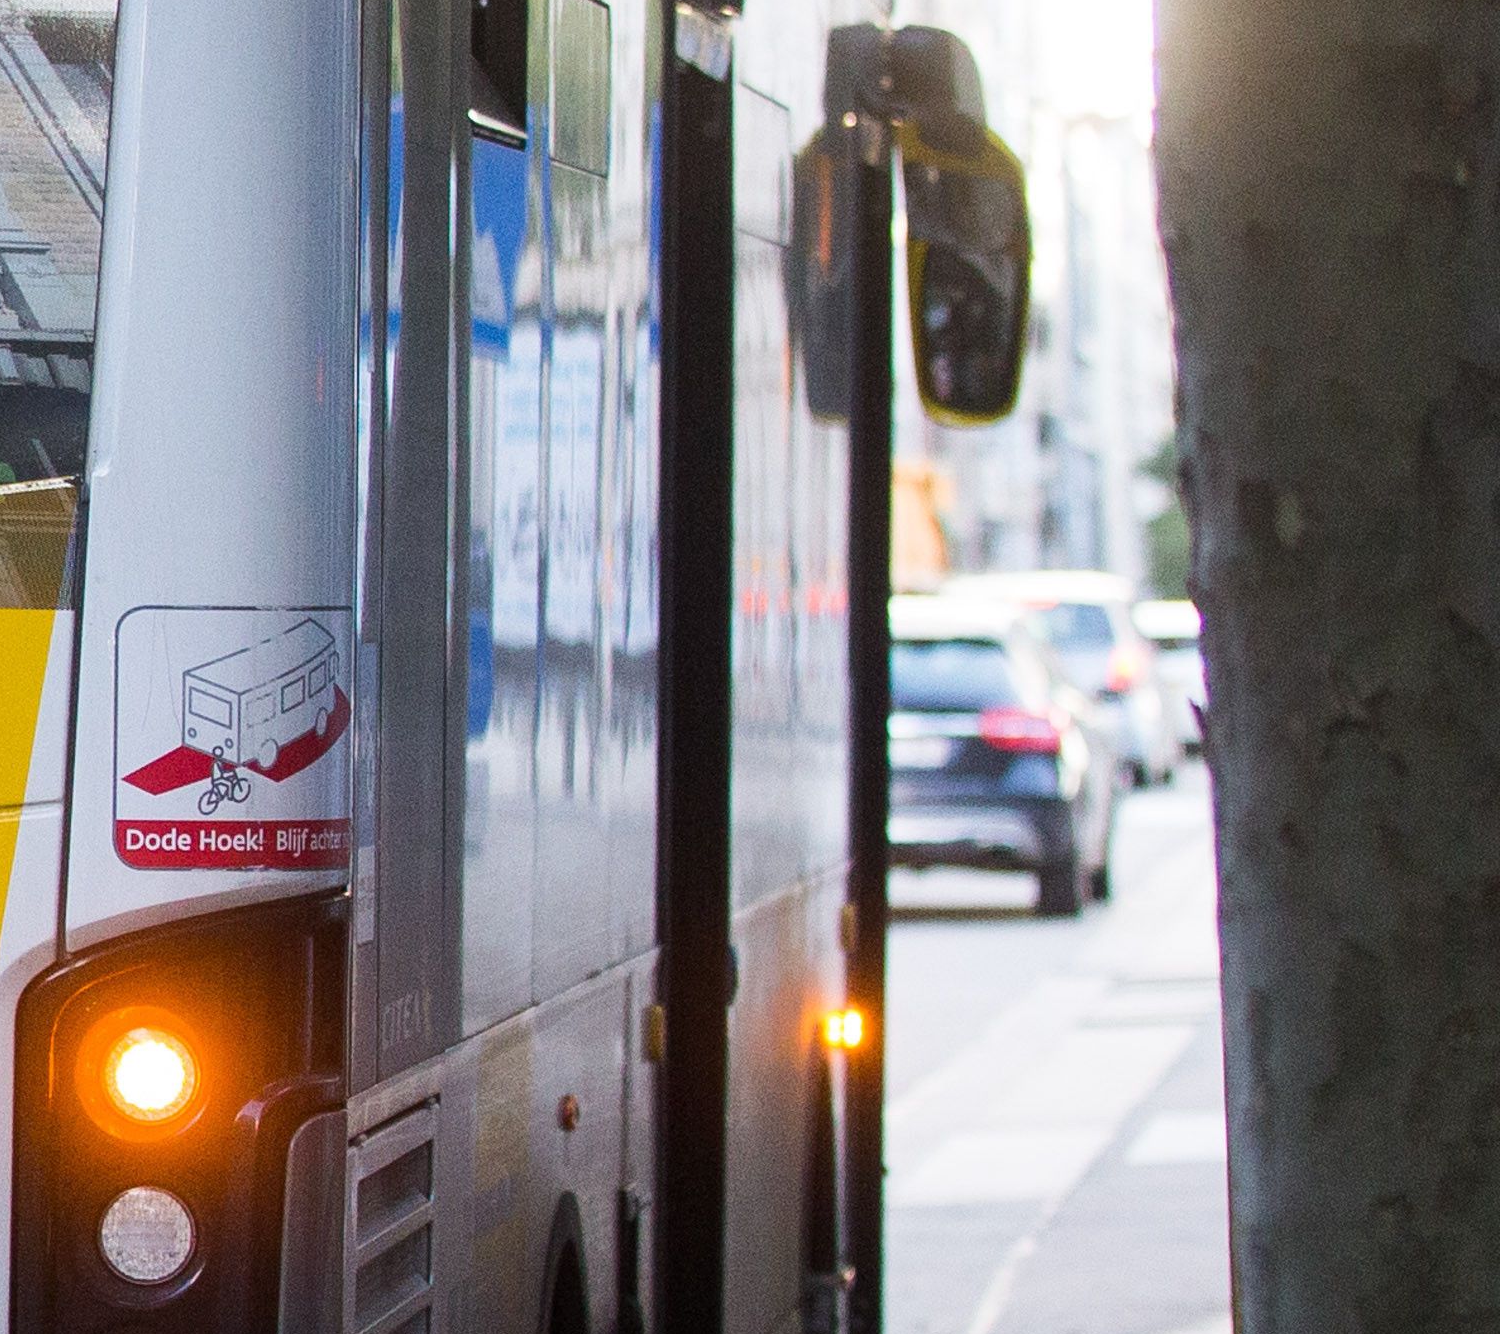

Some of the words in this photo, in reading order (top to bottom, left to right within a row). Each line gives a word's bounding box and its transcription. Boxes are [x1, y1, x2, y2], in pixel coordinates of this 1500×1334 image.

[124, 828, 192, 853] Dode
[199, 827, 264, 853] Hoek!
[275, 827, 309, 858] Blijf
